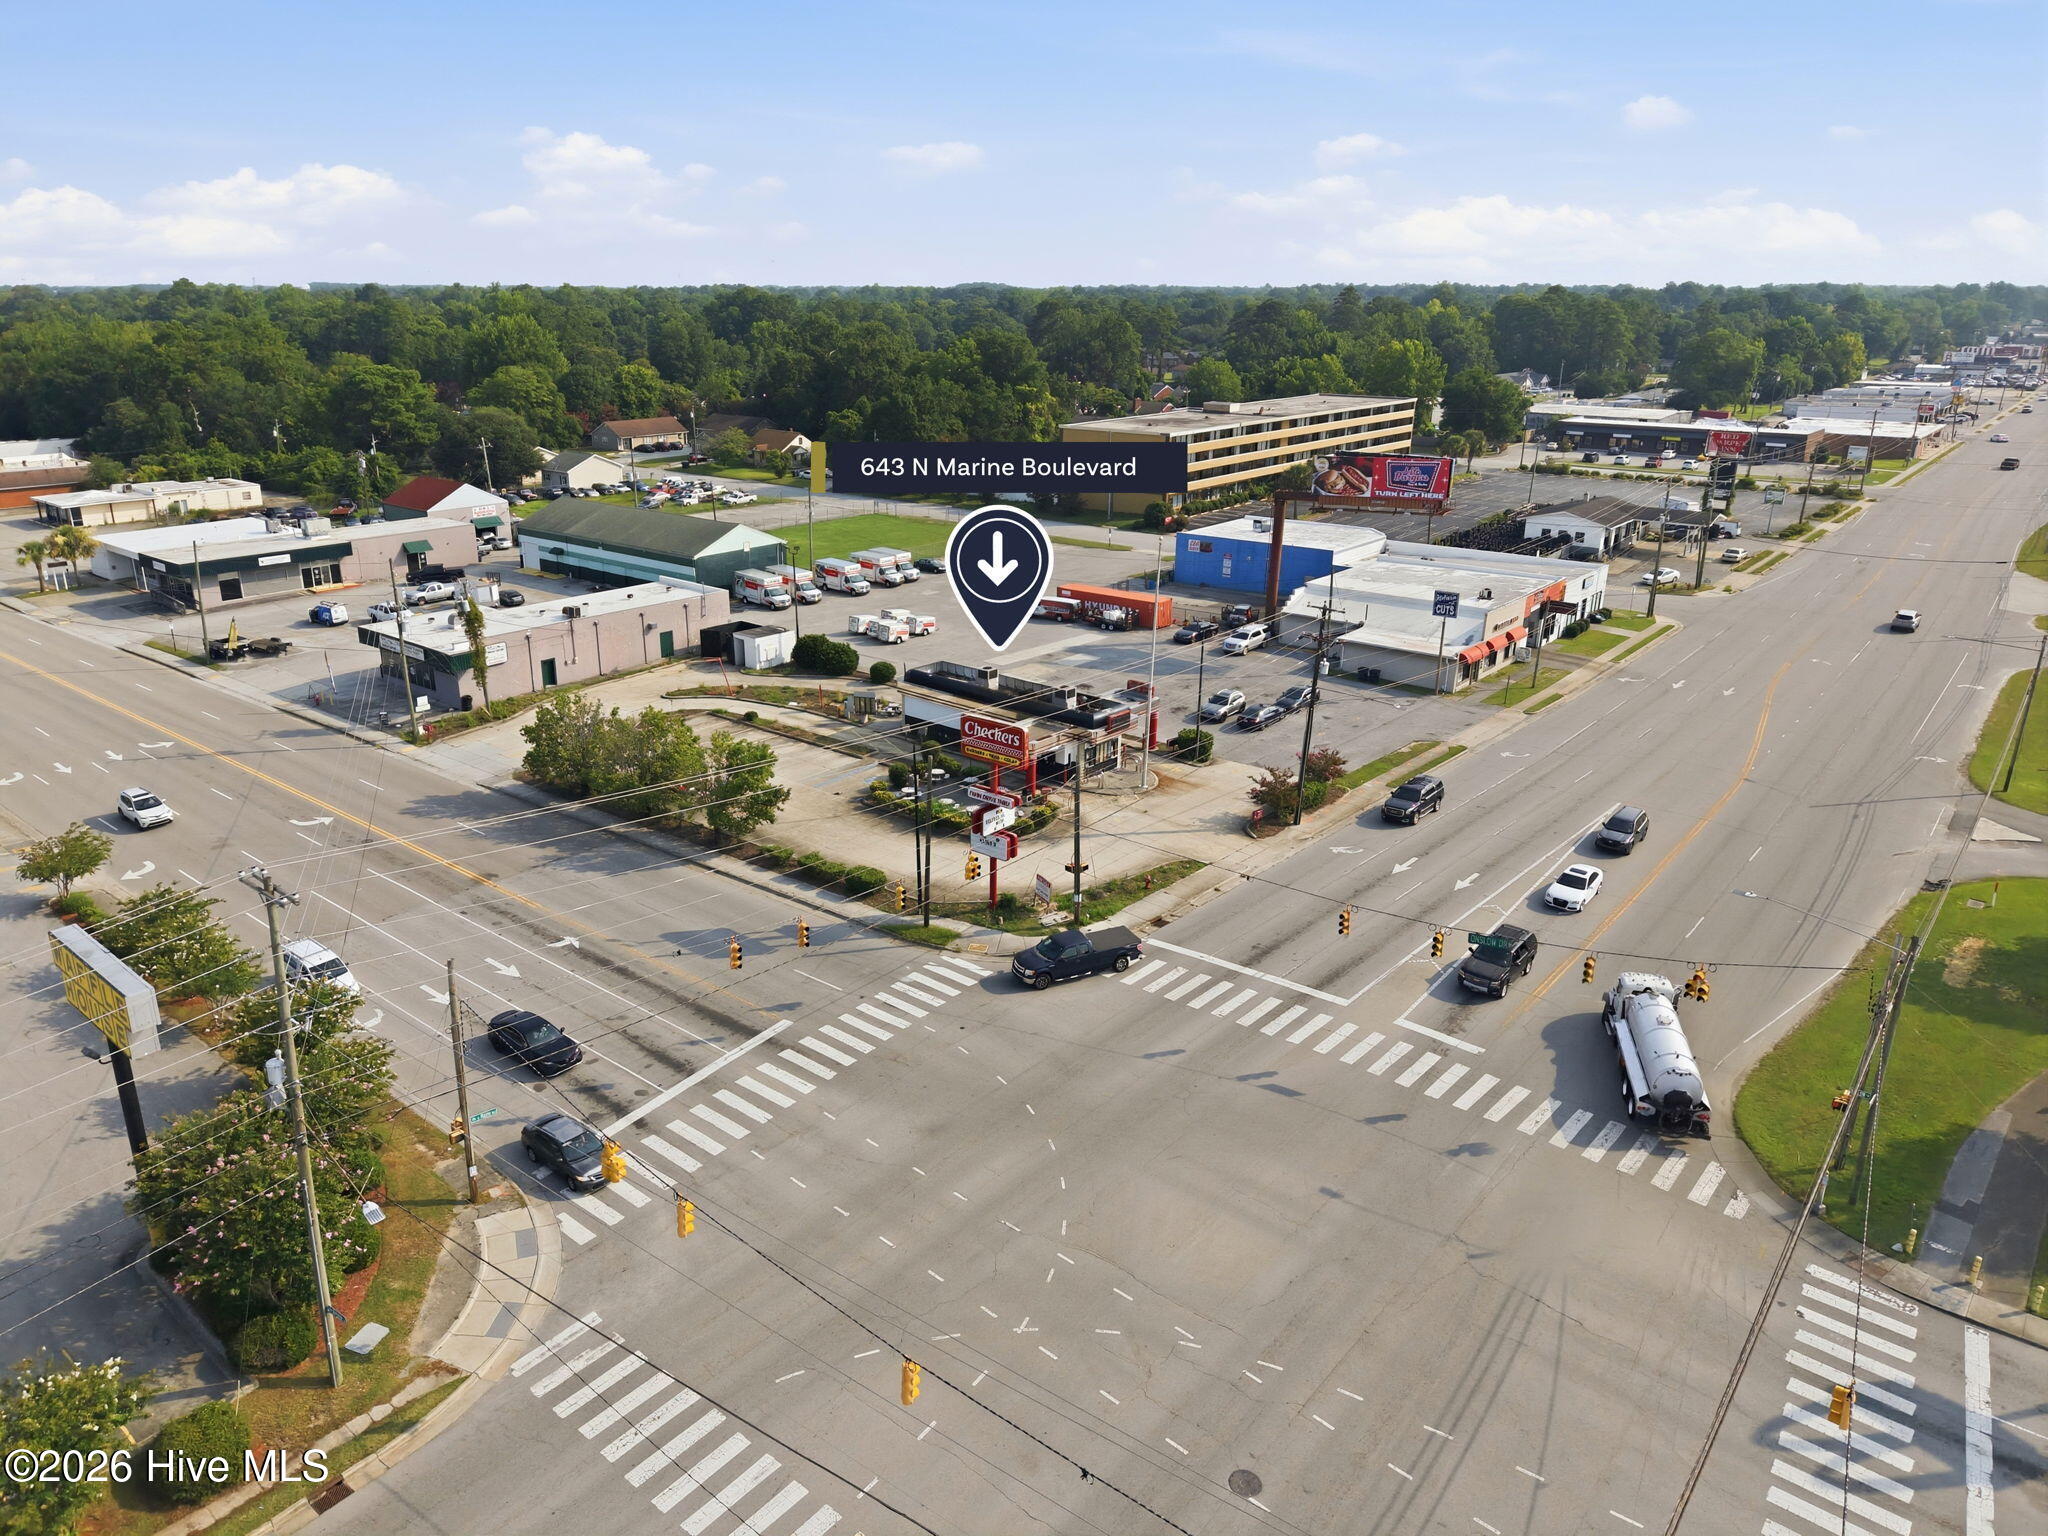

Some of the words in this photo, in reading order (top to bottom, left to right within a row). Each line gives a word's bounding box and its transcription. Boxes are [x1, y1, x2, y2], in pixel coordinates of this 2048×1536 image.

[1435, 604, 1455, 616] CUTS
[964, 721, 1020, 747] Checkers
[53, 944, 131, 1026] WAFFLE
[66, 977, 128, 1047] HOUSE
